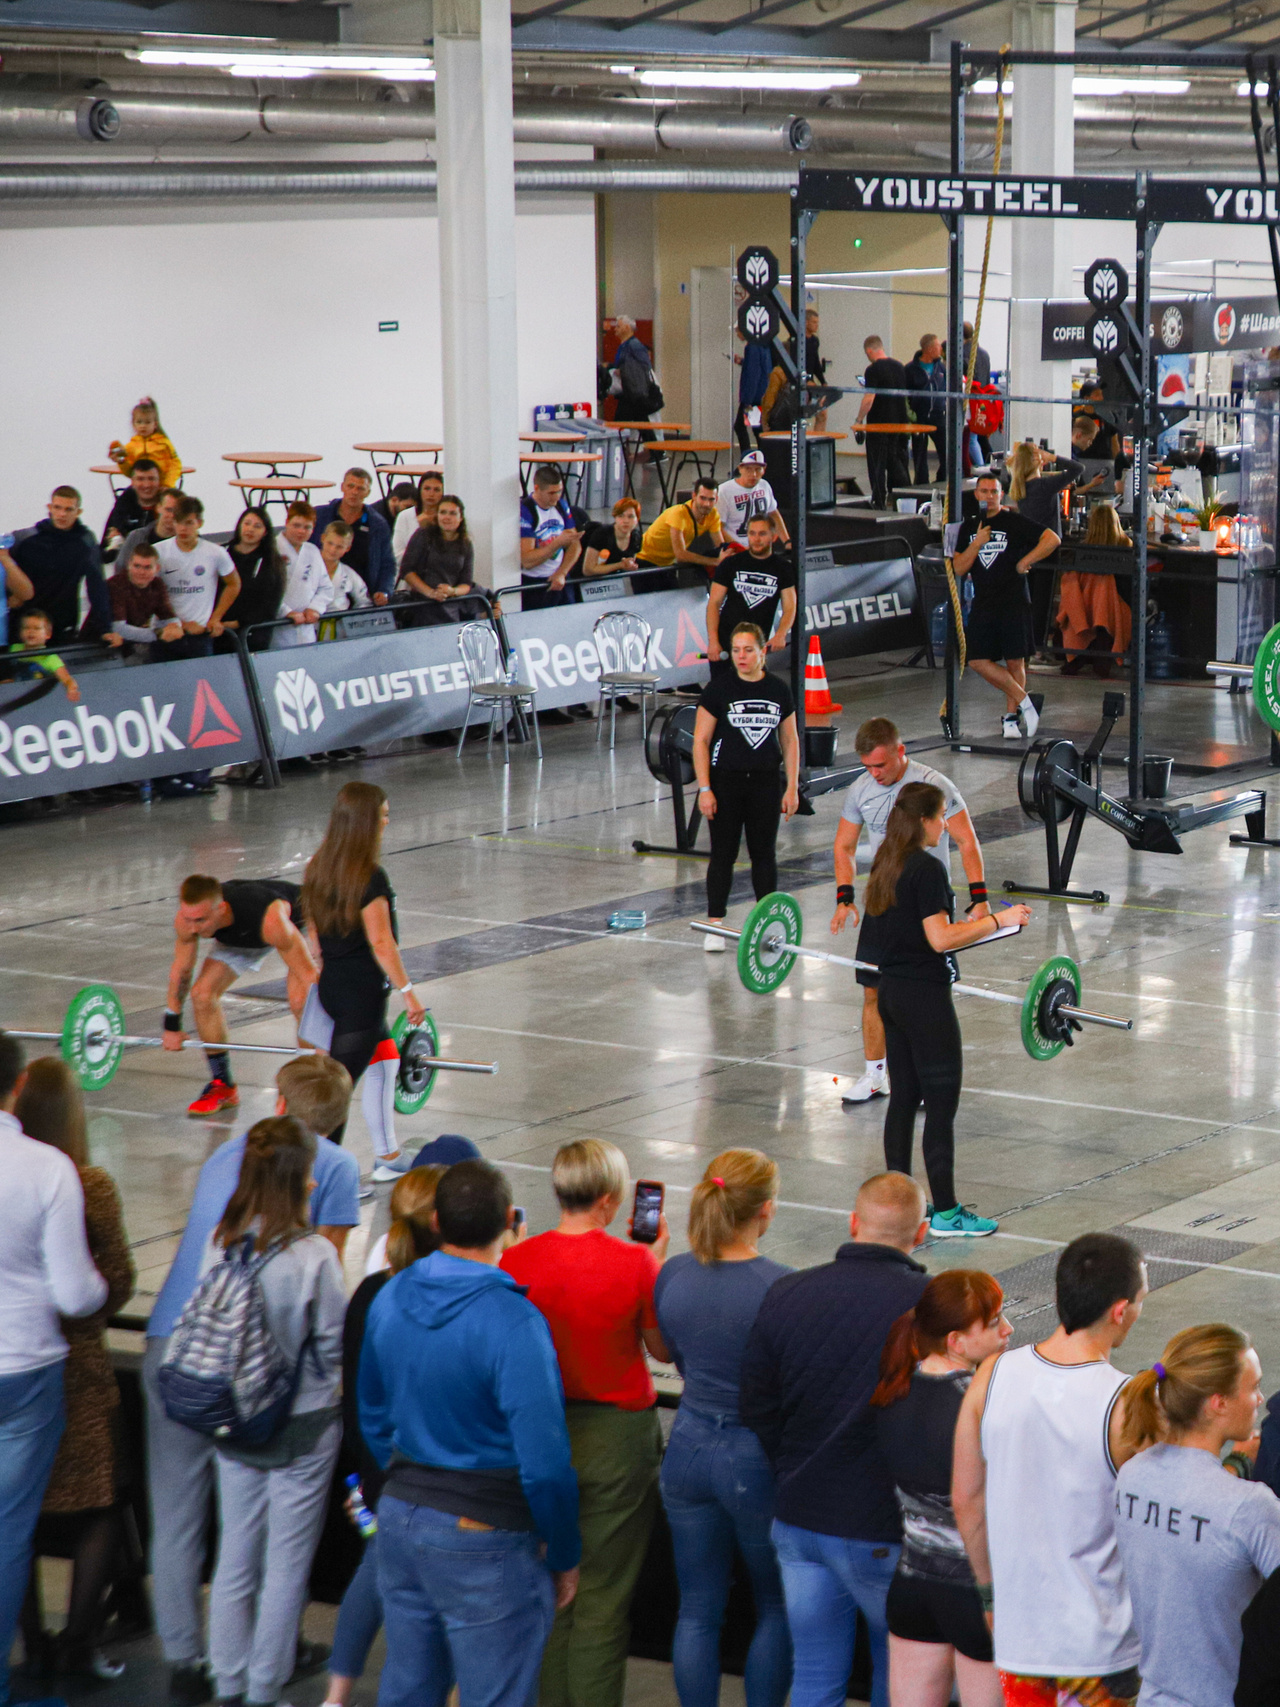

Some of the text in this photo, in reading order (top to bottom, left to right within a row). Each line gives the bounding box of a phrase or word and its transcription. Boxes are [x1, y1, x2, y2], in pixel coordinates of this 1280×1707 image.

[855, 177, 1079, 213] YOUSTEEL
[805, 592, 911, 631] OUSTEEL
[520, 621, 673, 690] Reebok
